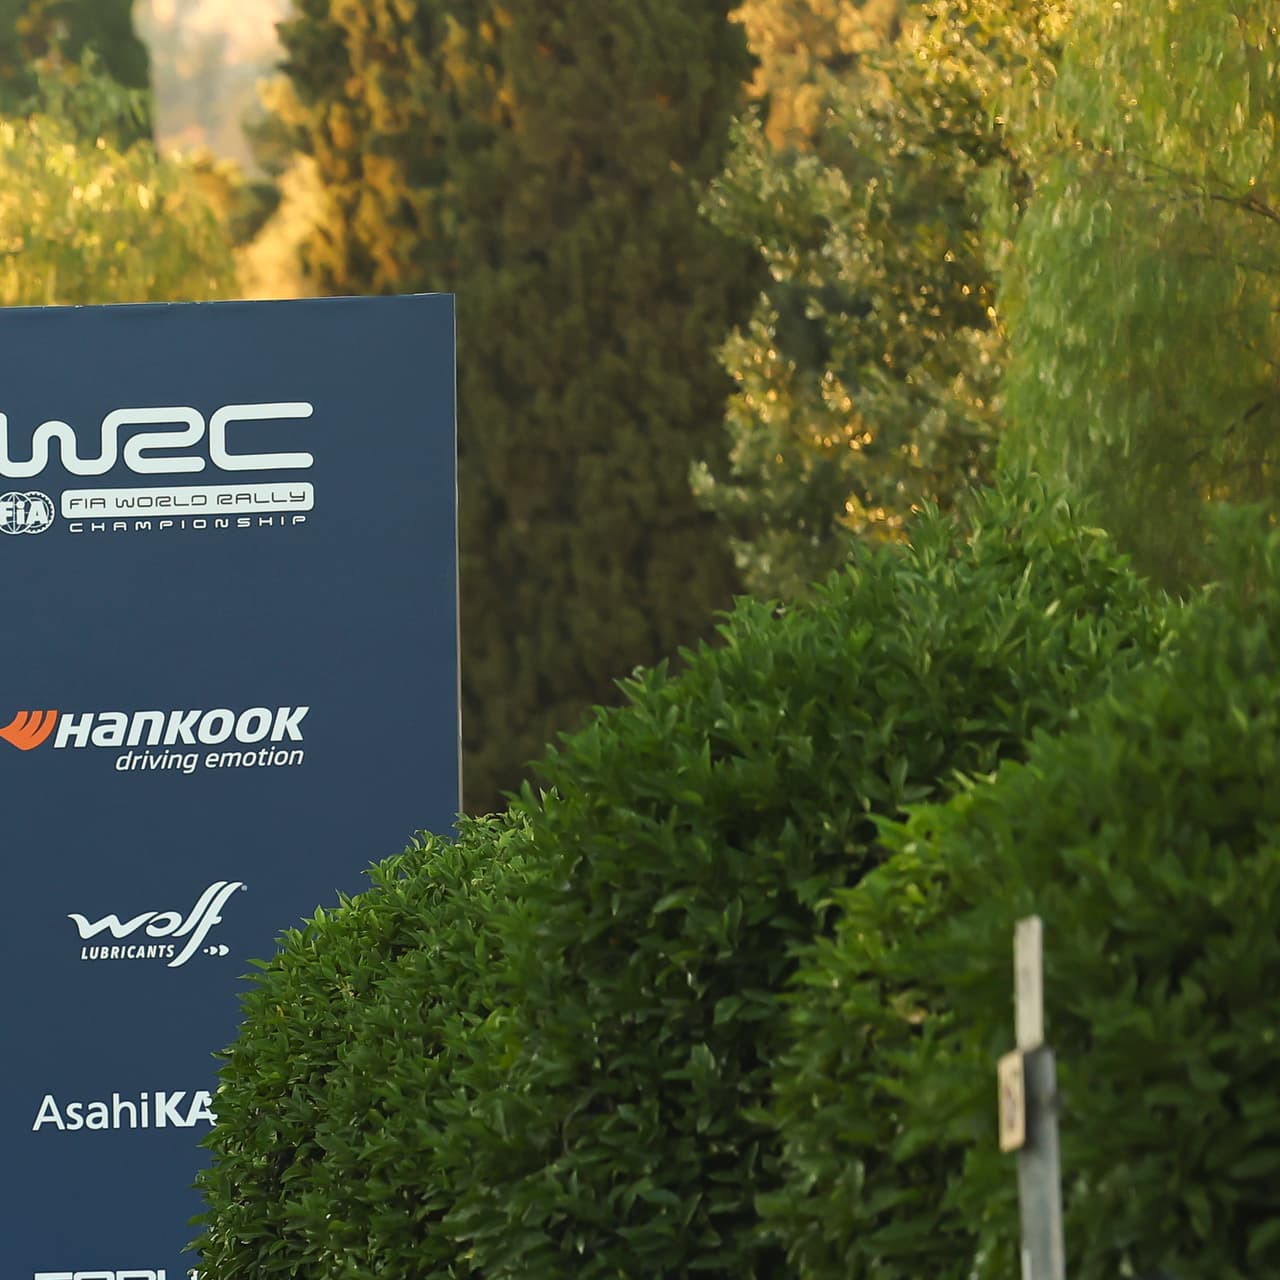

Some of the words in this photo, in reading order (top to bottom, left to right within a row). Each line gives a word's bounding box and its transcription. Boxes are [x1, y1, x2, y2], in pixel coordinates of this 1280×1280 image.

[70, 497, 106, 511] FIA
[115, 494, 208, 508] WORLD
[217, 491, 306, 505] RALLY
[69, 515, 307, 534] CHAMPIONSHIP
[115, 749, 199, 775] driving
[204, 746, 305, 768] emotion
[80, 944, 176, 961] LUBRICANTS
[32, 1090, 218, 1131] AsahiKA
